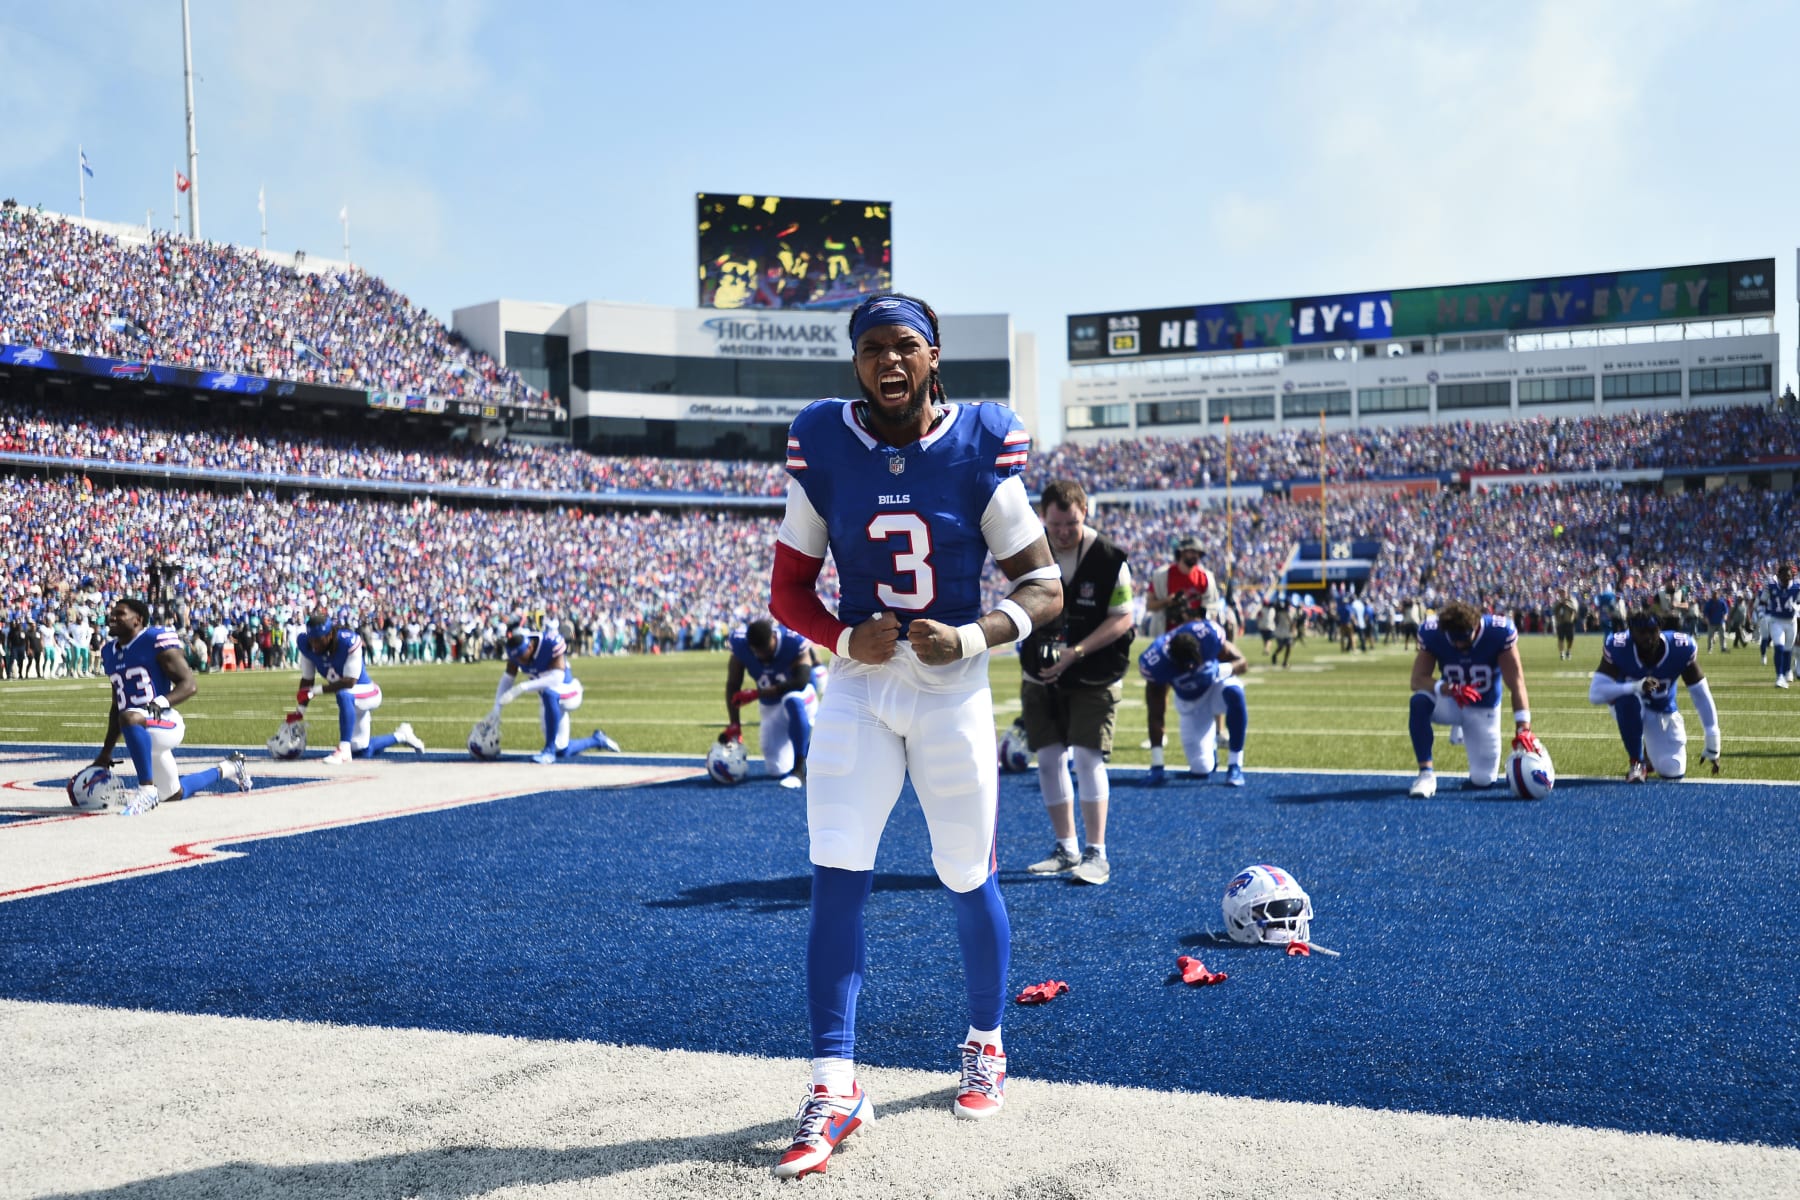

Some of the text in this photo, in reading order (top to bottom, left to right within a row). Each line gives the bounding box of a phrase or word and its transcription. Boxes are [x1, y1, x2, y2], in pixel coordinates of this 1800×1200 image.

[717, 320, 838, 343] HIGHMARK
[719, 344, 838, 358] WESTERN NEW YORK
[689, 404, 732, 416] Official
[736, 406, 773, 416] Health
[878, 494, 911, 505] BILLS
[865, 512, 937, 613] 3
